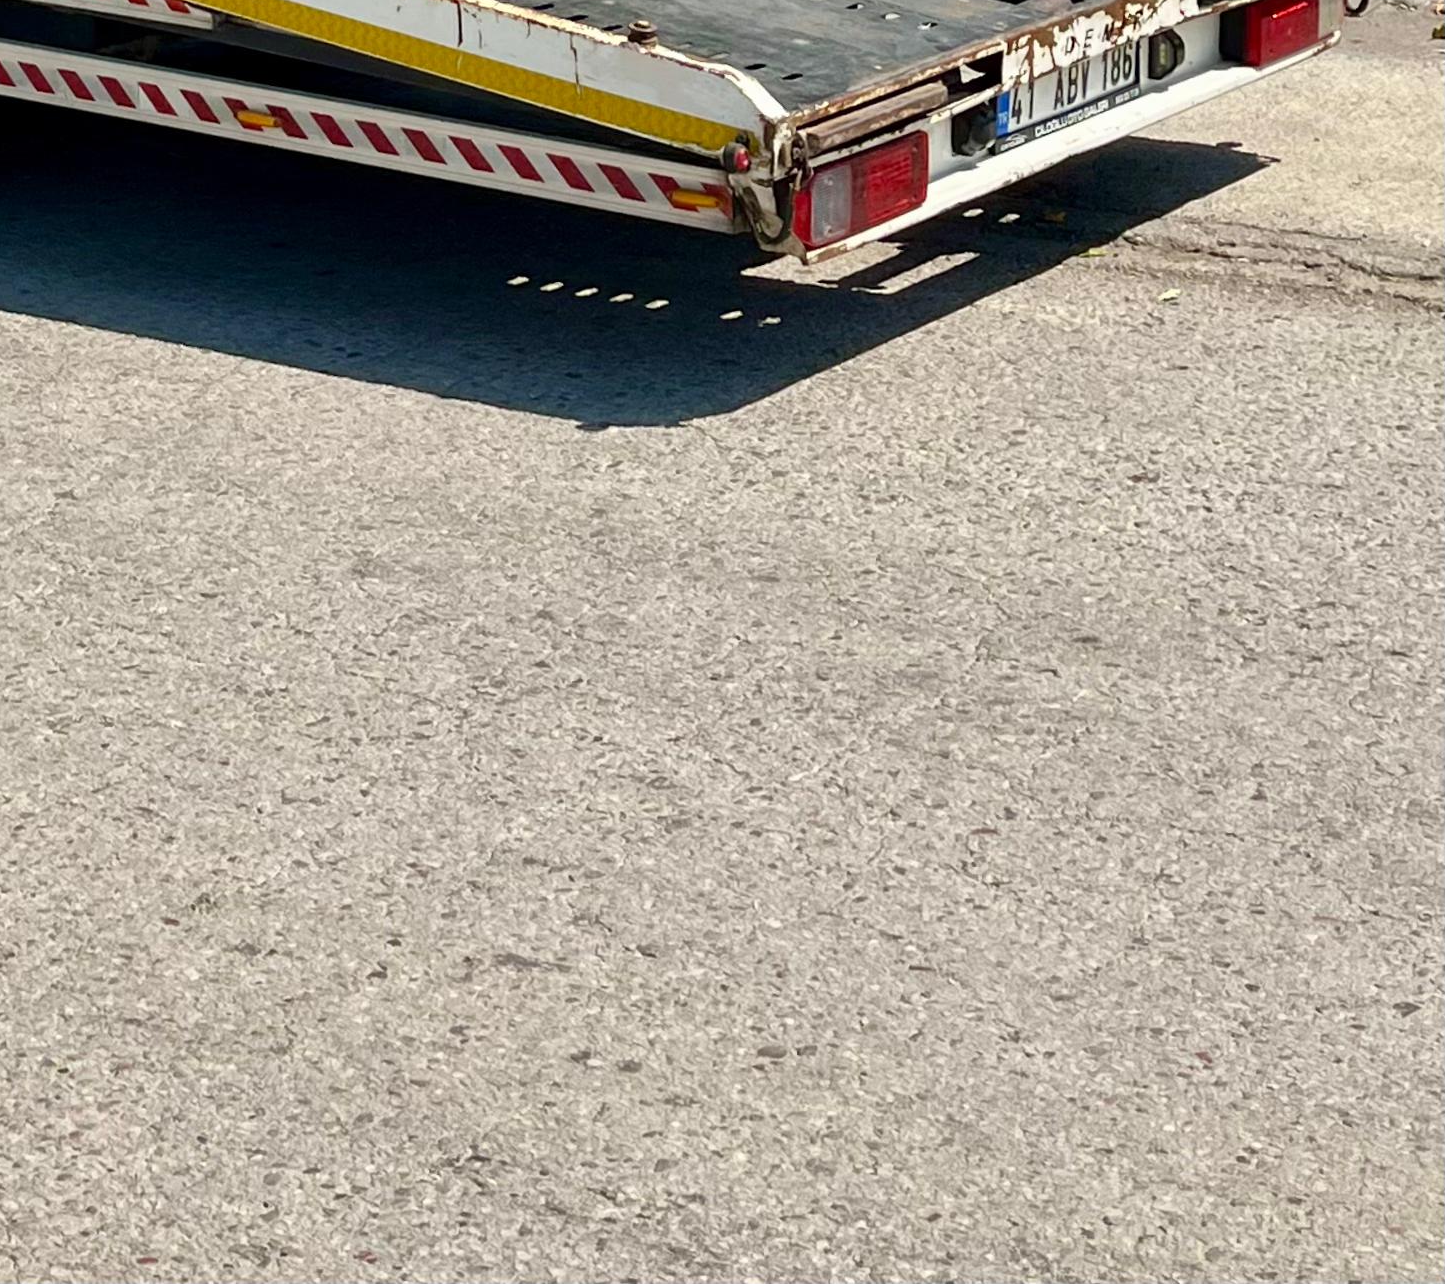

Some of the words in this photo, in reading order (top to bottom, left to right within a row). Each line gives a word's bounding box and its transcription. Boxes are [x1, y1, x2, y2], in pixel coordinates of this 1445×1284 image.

[1010, 81, 1035, 126] 41
[1053, 59, 1092, 111] ABV
[1102, 42, 1133, 91] 186
